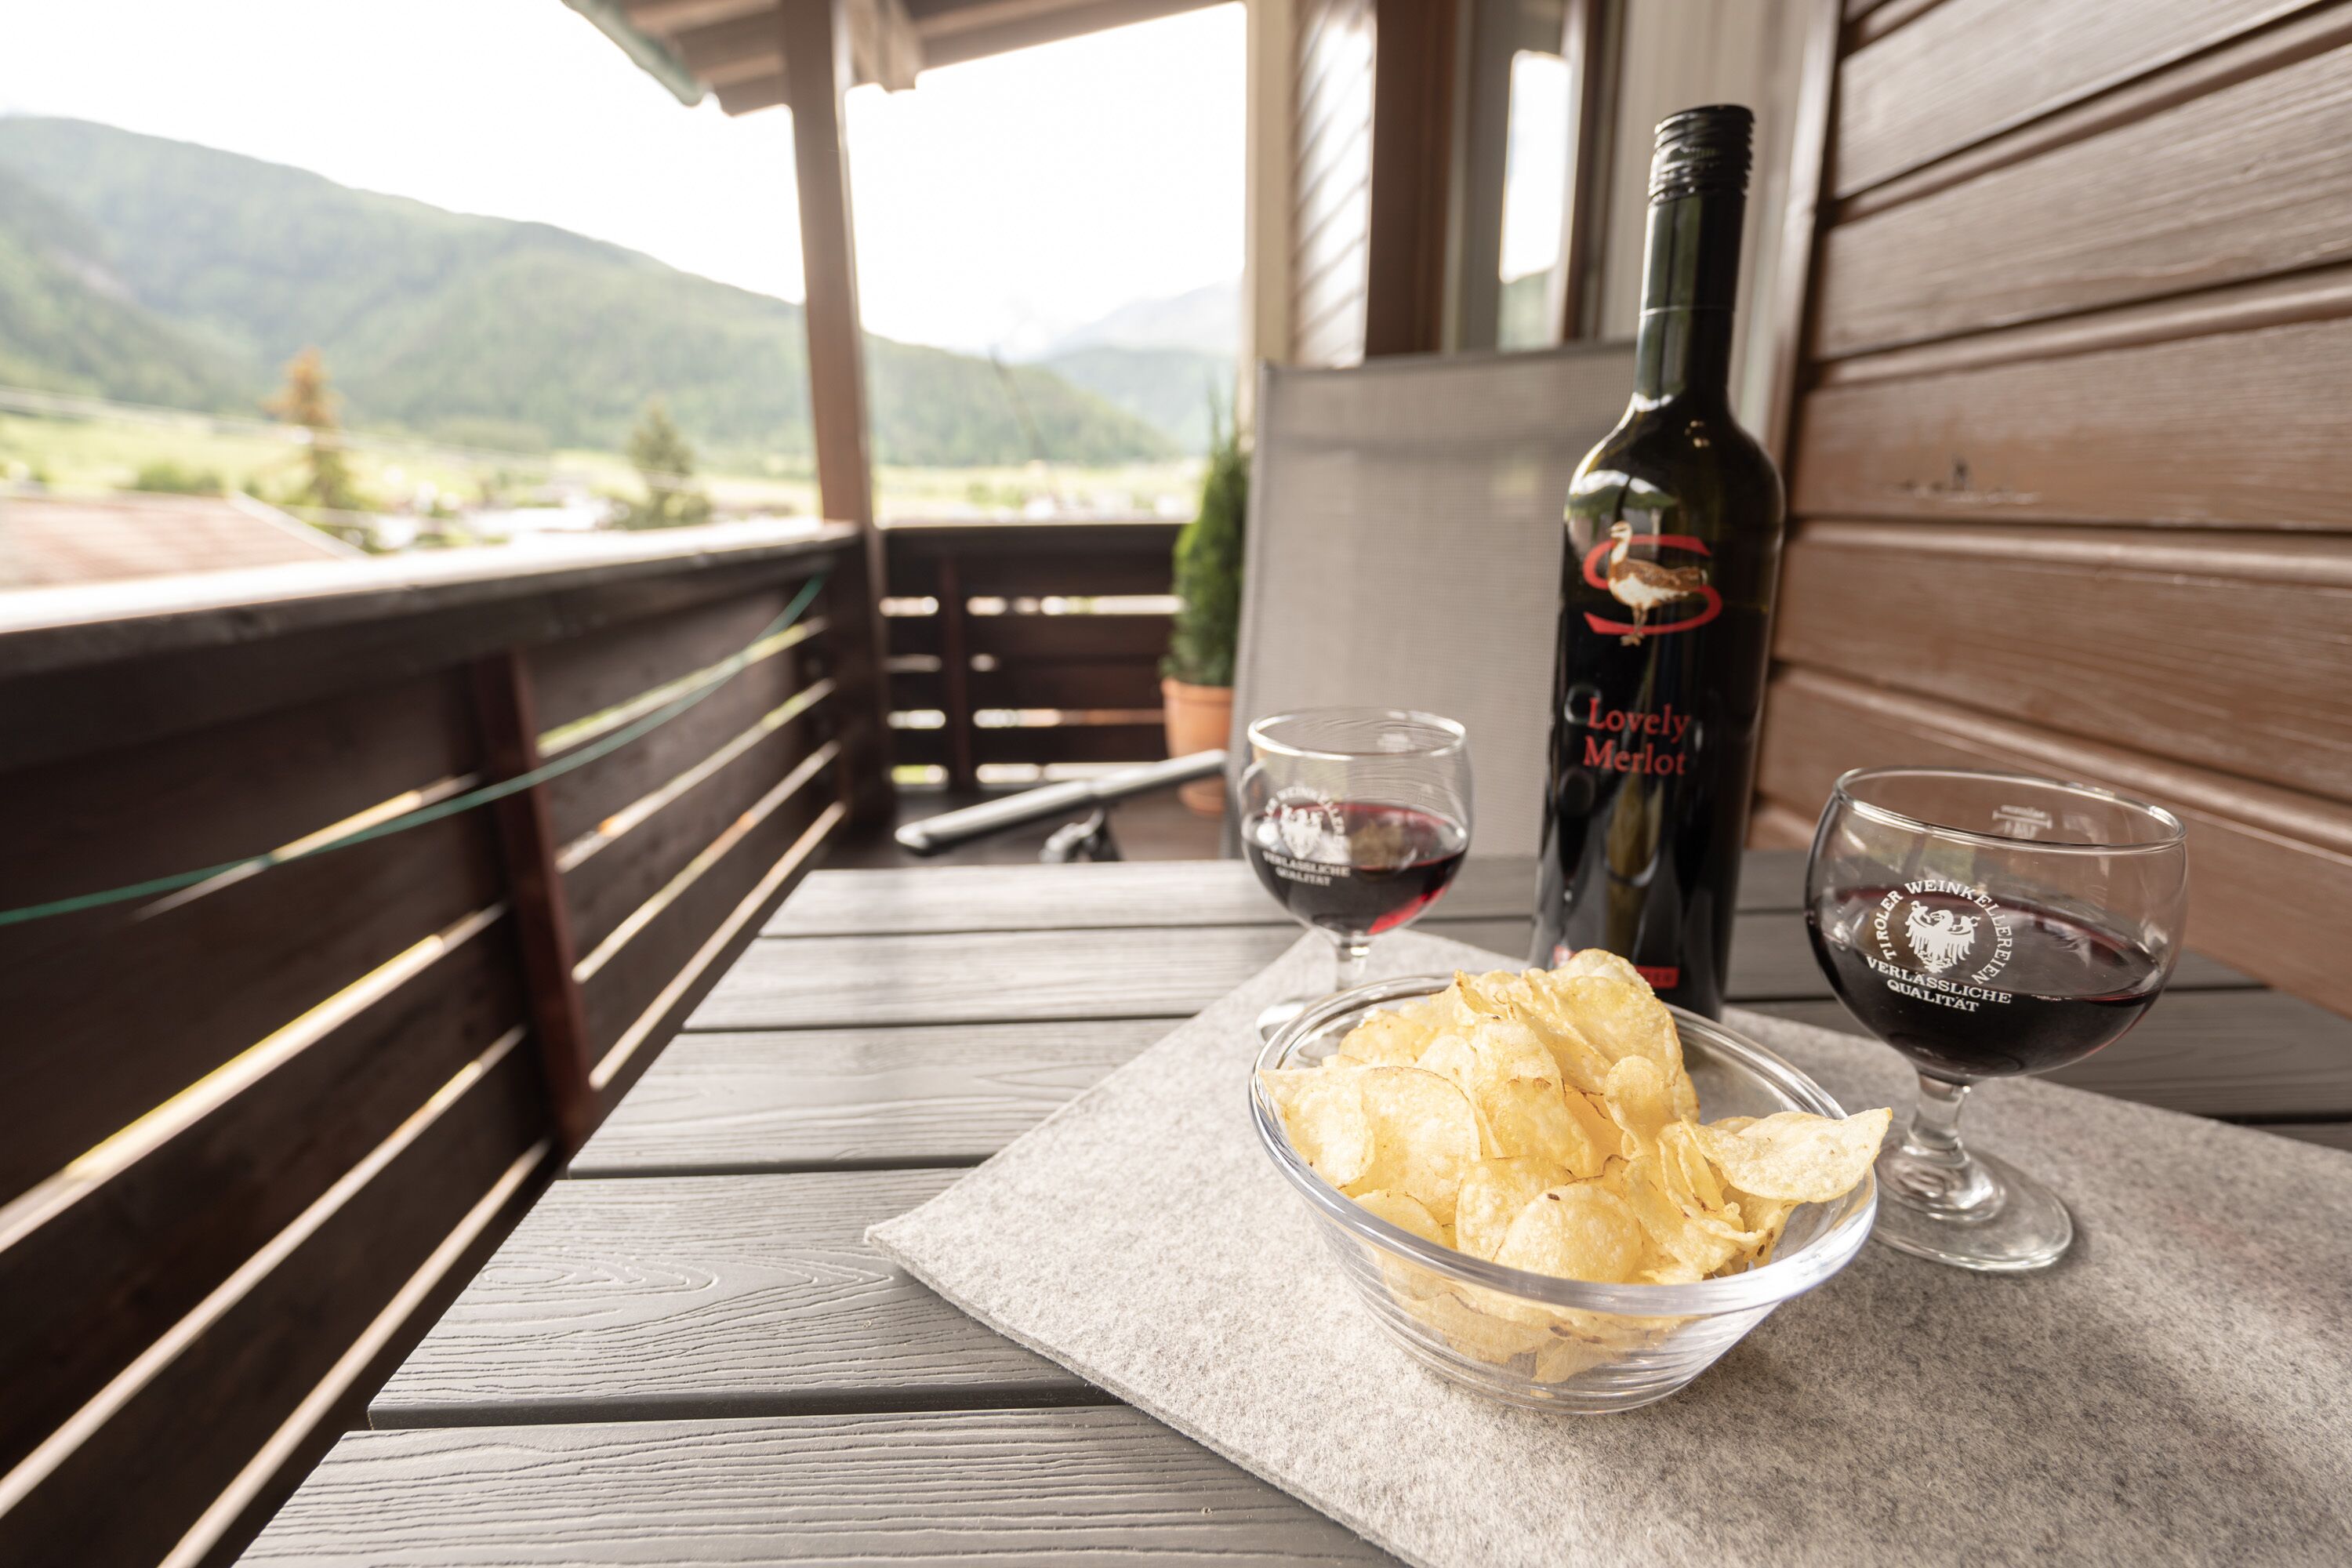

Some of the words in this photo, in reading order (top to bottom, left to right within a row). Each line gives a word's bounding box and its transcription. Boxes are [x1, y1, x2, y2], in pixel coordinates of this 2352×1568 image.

[1586, 697, 1691, 744] Lovely
[1582, 735, 1688, 776] Merlot
[1874, 890, 1903, 960] TIROLER
[1904, 880, 2013, 985] WEINKELLEREIEN
[1866, 955, 2012, 1004] VERLÄSSLICHE
[1886, 979, 1980, 1013] QUALITÄT
